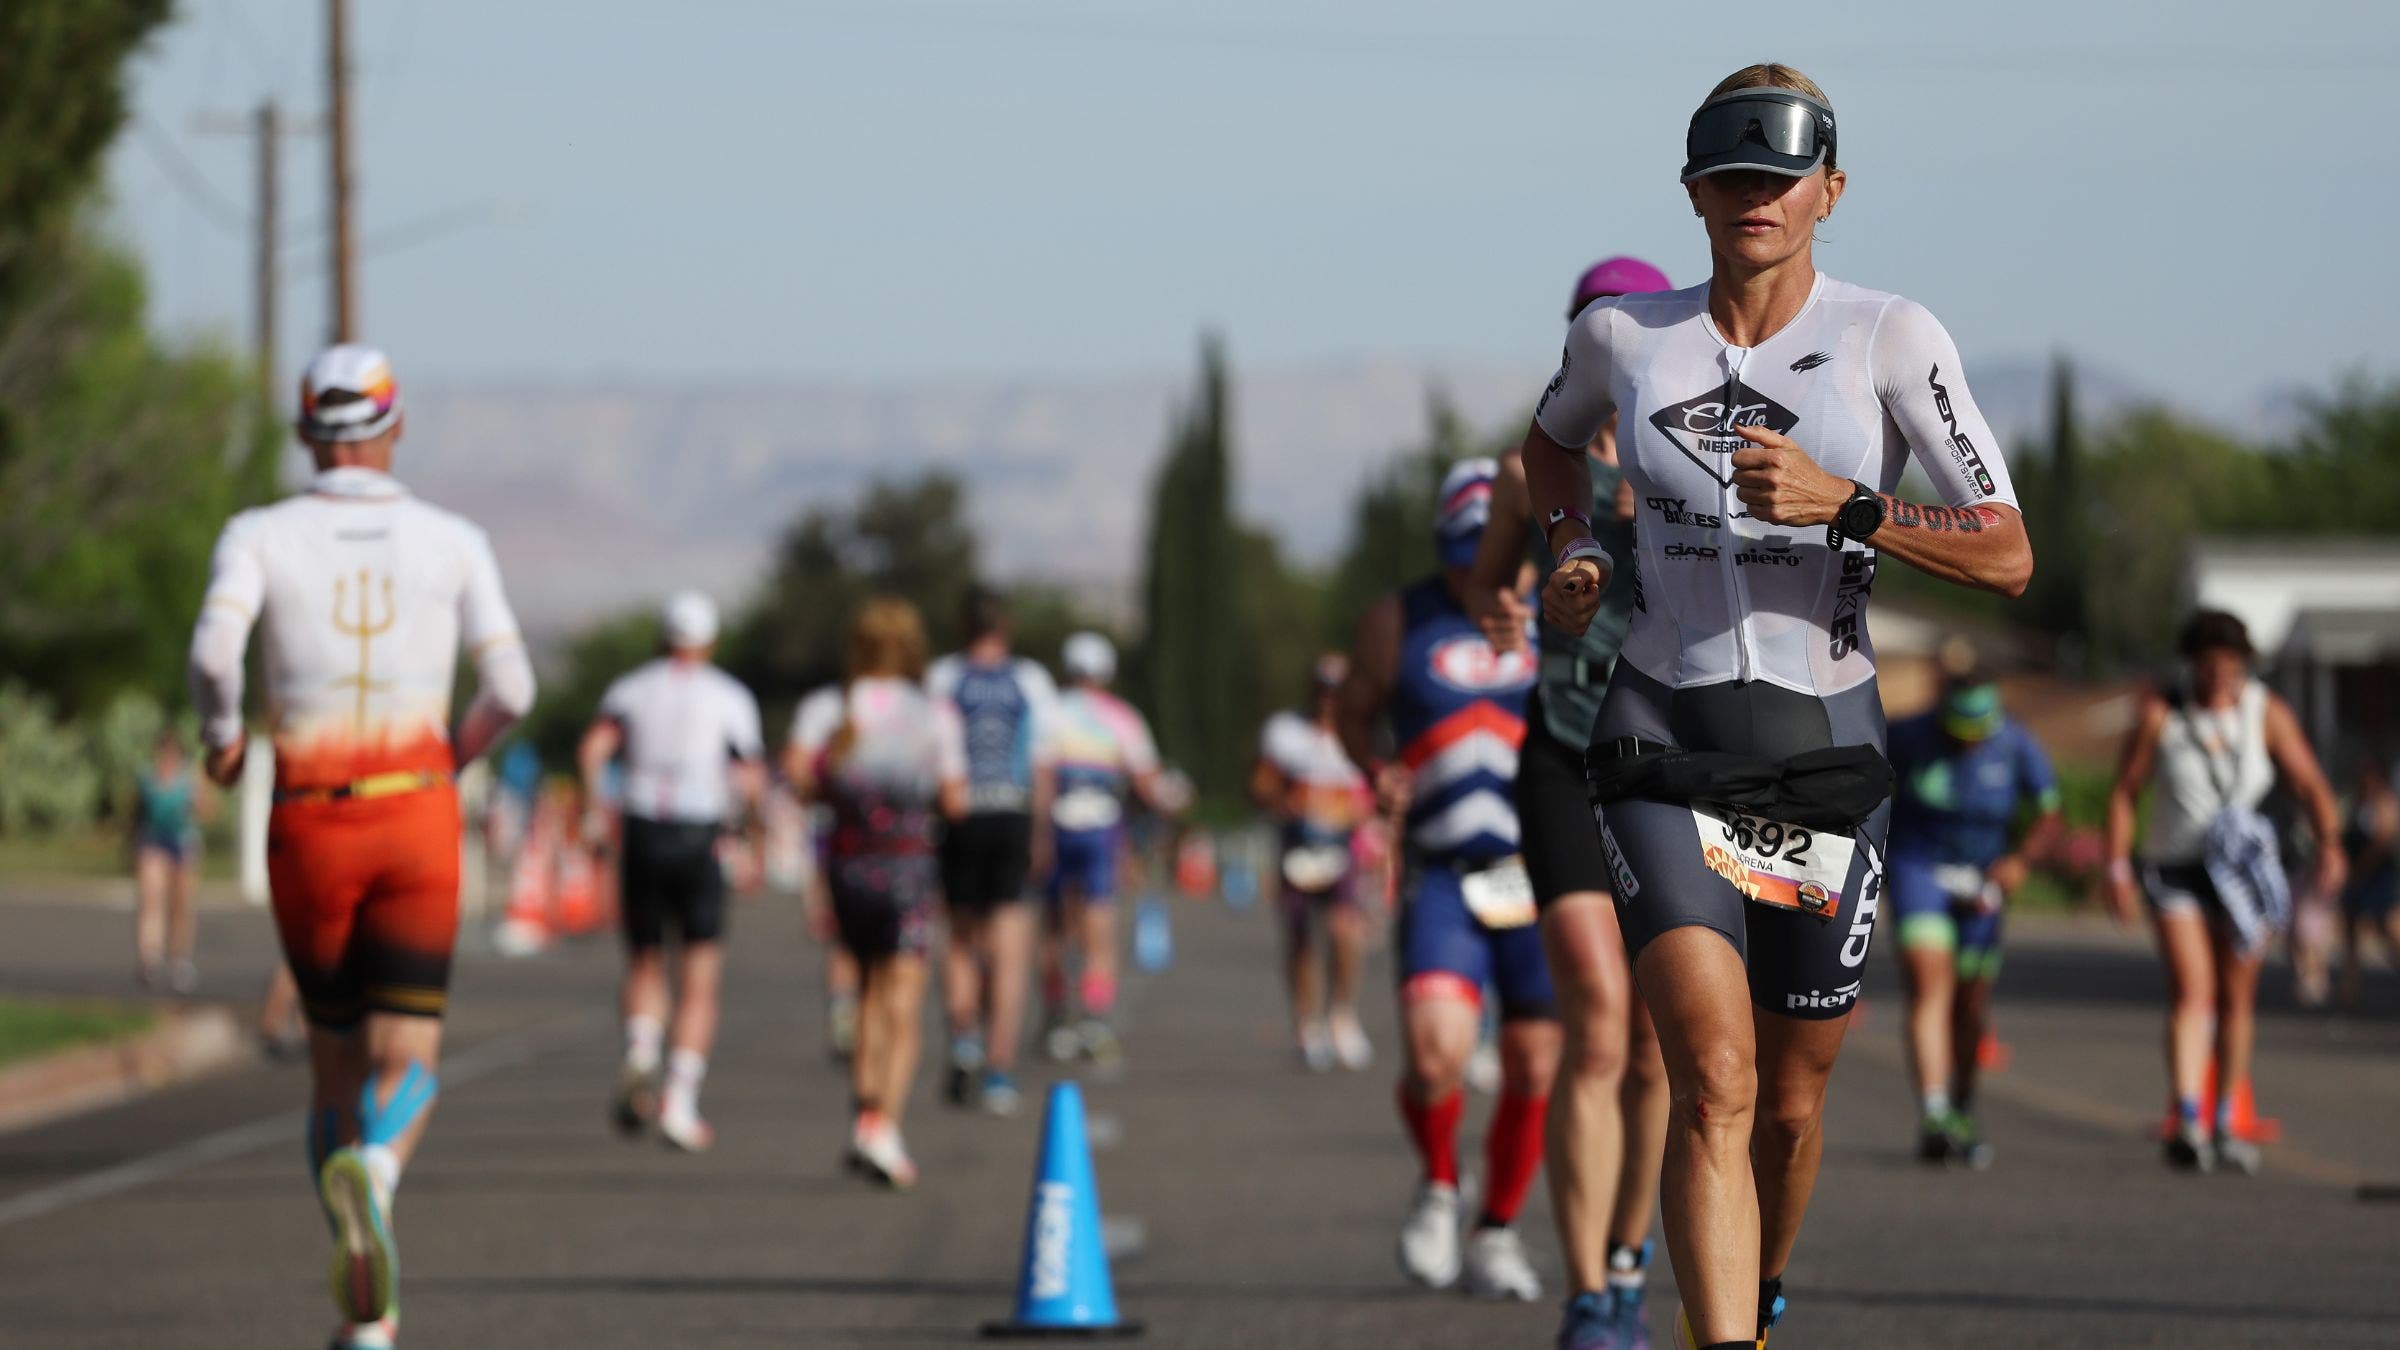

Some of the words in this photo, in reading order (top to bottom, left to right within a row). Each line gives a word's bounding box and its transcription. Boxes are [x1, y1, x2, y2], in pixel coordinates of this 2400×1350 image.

[1682, 402, 1767, 433] Estlo
[1928, 362, 1996, 496] VENETO
[1697, 438, 1751, 453] NEGRO
[1944, 438, 1983, 500] SPORTSWEAR
[1663, 510, 1721, 529] BIKES
[1735, 548, 1800, 567] piero
[1830, 550, 1864, 661] BIKES
